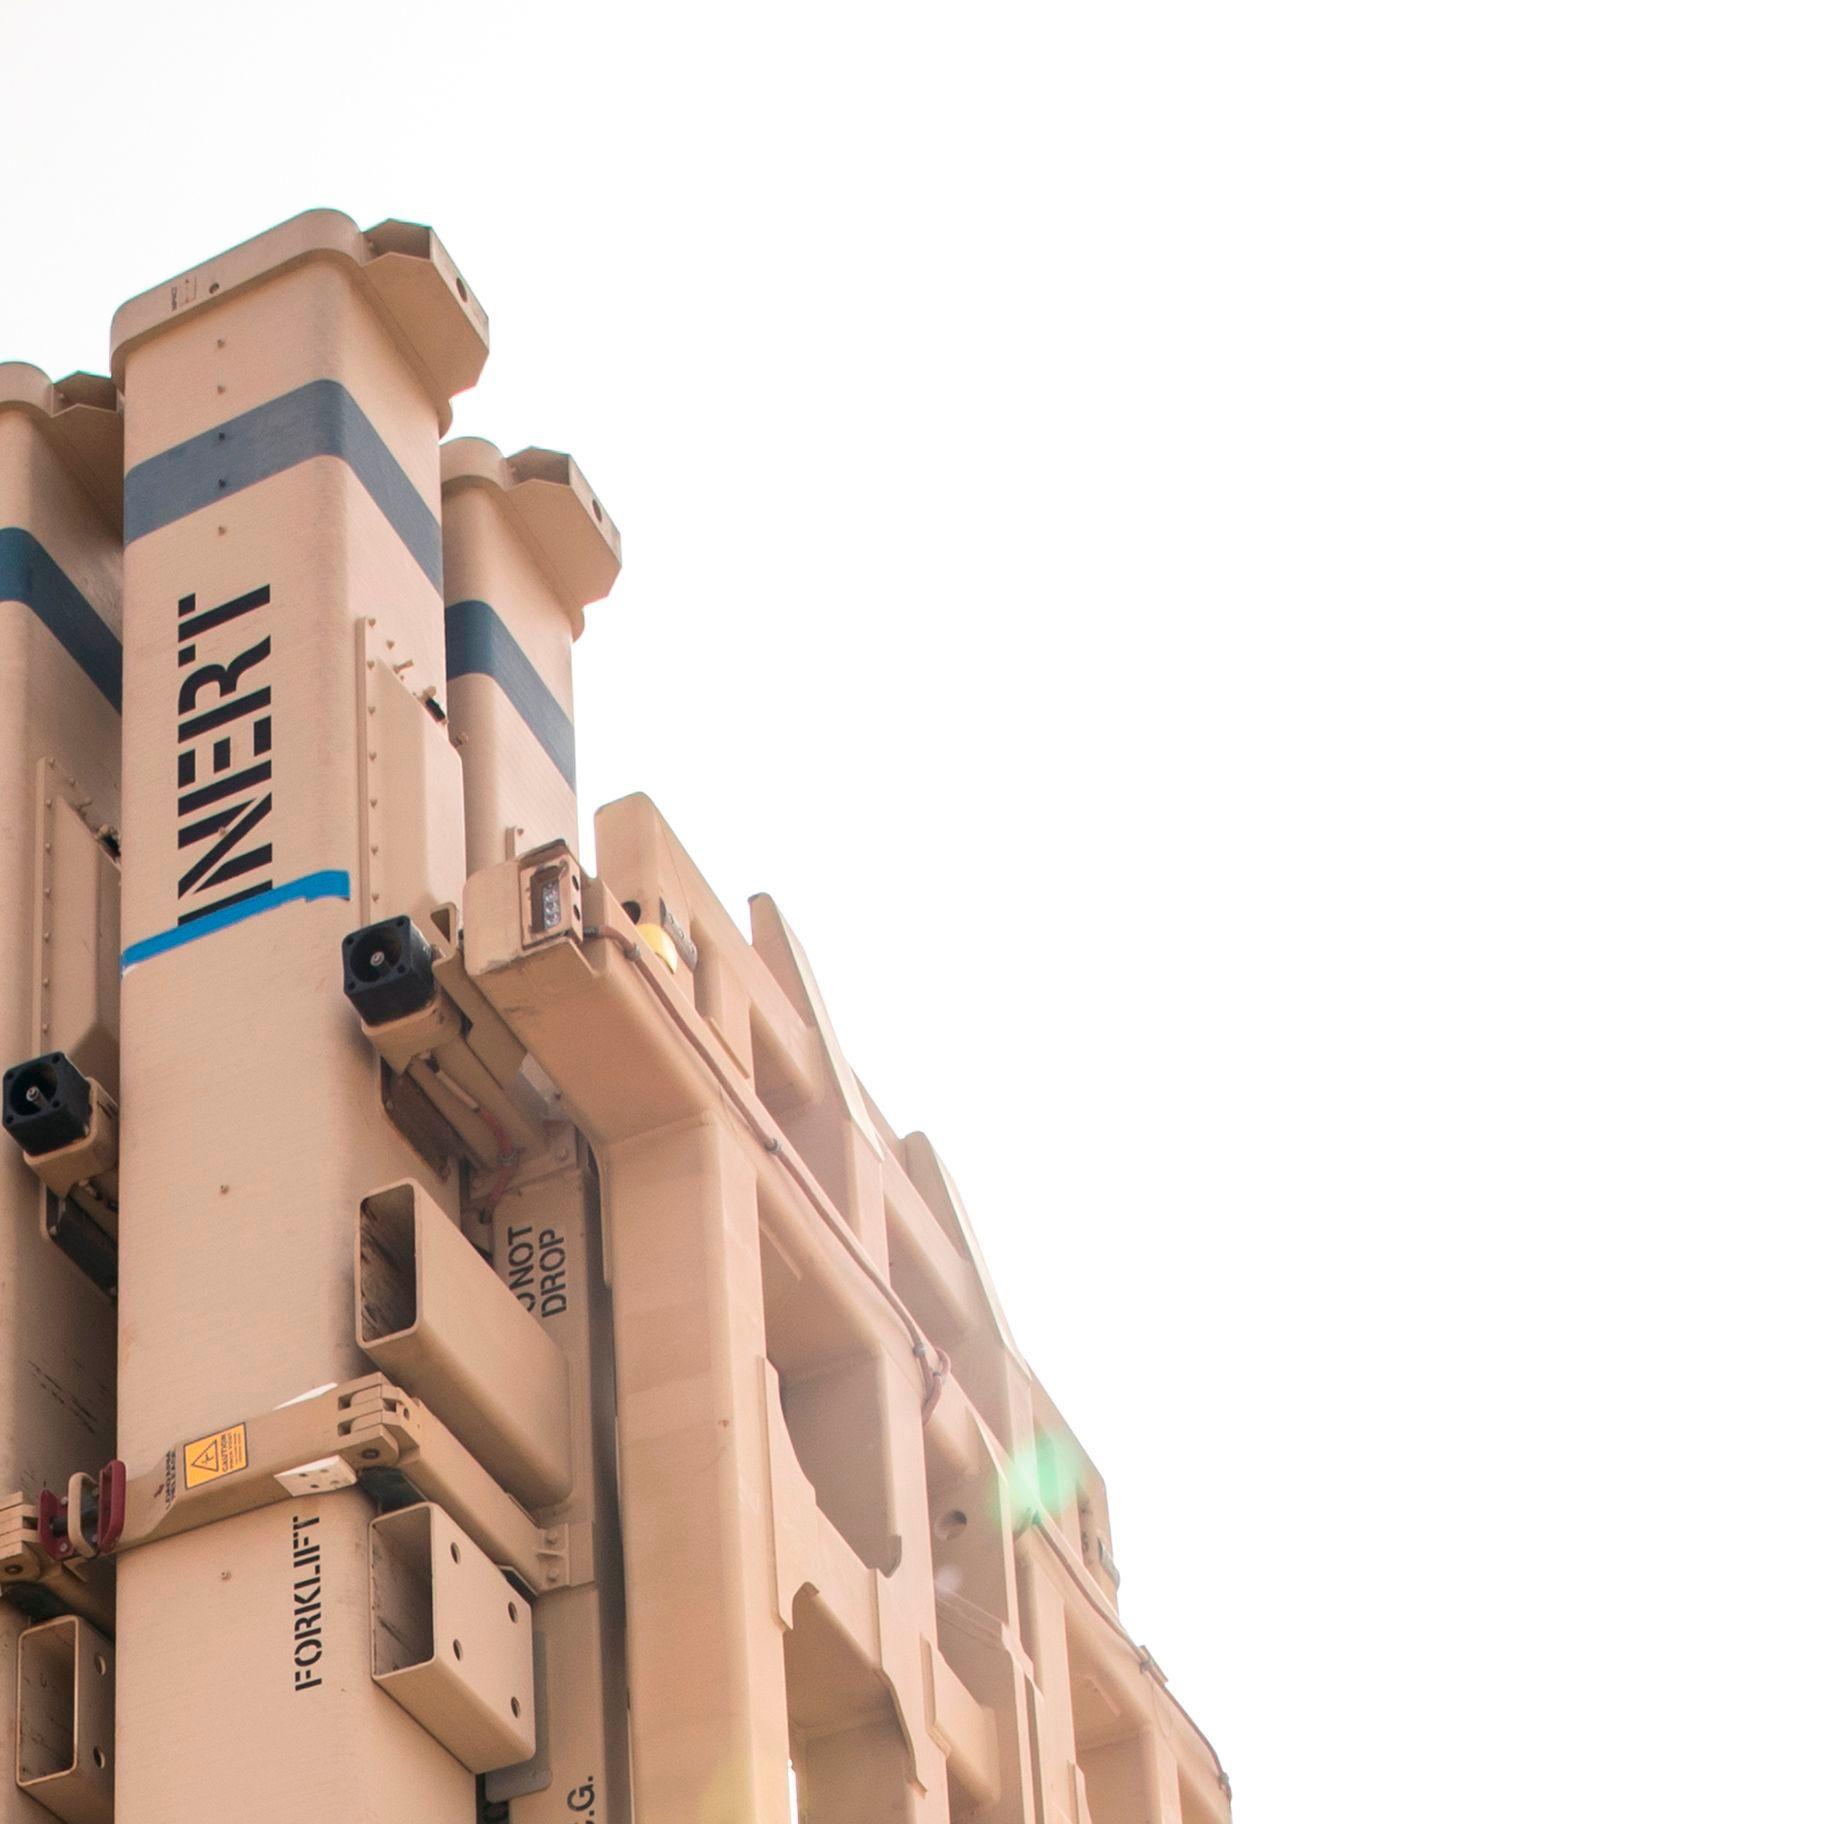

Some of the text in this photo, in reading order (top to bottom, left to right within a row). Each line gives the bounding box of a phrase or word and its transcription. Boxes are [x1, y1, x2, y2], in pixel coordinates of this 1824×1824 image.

[178, 584, 272, 926] INERT
[507, 1226, 534, 1290] NOT
[539, 1229, 567, 1317] DROP
[293, 1515, 322, 1691] FORKLIFT
